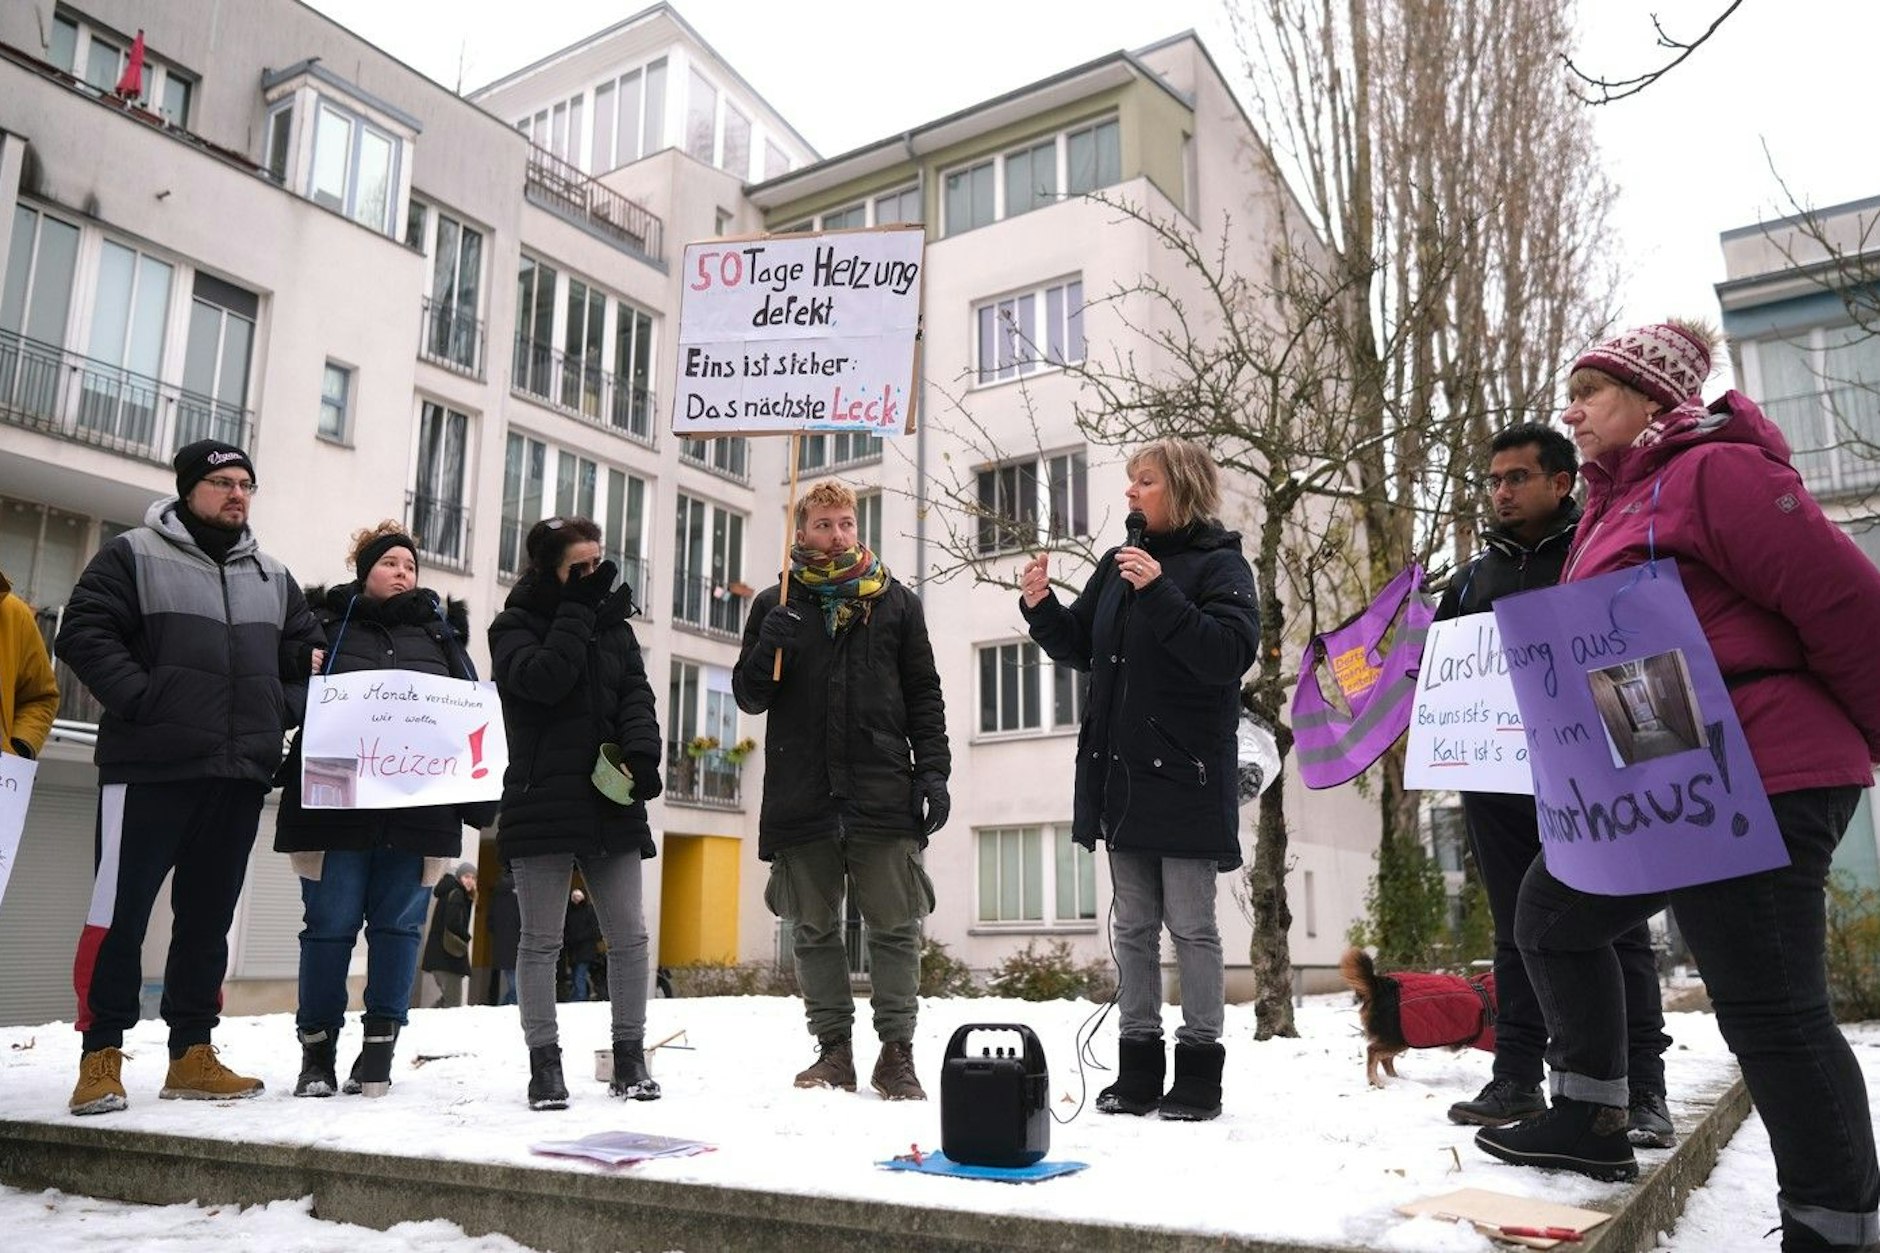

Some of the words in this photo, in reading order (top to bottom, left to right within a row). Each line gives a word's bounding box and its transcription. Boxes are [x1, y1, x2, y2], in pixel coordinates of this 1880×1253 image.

[690, 251, 743, 291] 50
[743, 248, 804, 292] Tage
[813, 246, 919, 295] Heizung
[685, 348, 735, 378] Eins
[743, 353, 769, 377] ist
[687, 393, 738, 420] Das
[744, 392, 825, 420] nächste
[831, 384, 898, 426] Leck
[1571, 630, 1628, 665] aus
[320, 687, 349, 704] Die
[363, 682, 419, 700] Monate
[372, 711, 393, 723] wir
[1418, 704, 1436, 726] Bei
[1553, 723, 1590, 745] im
[1433, 737, 1467, 762] Kalt
